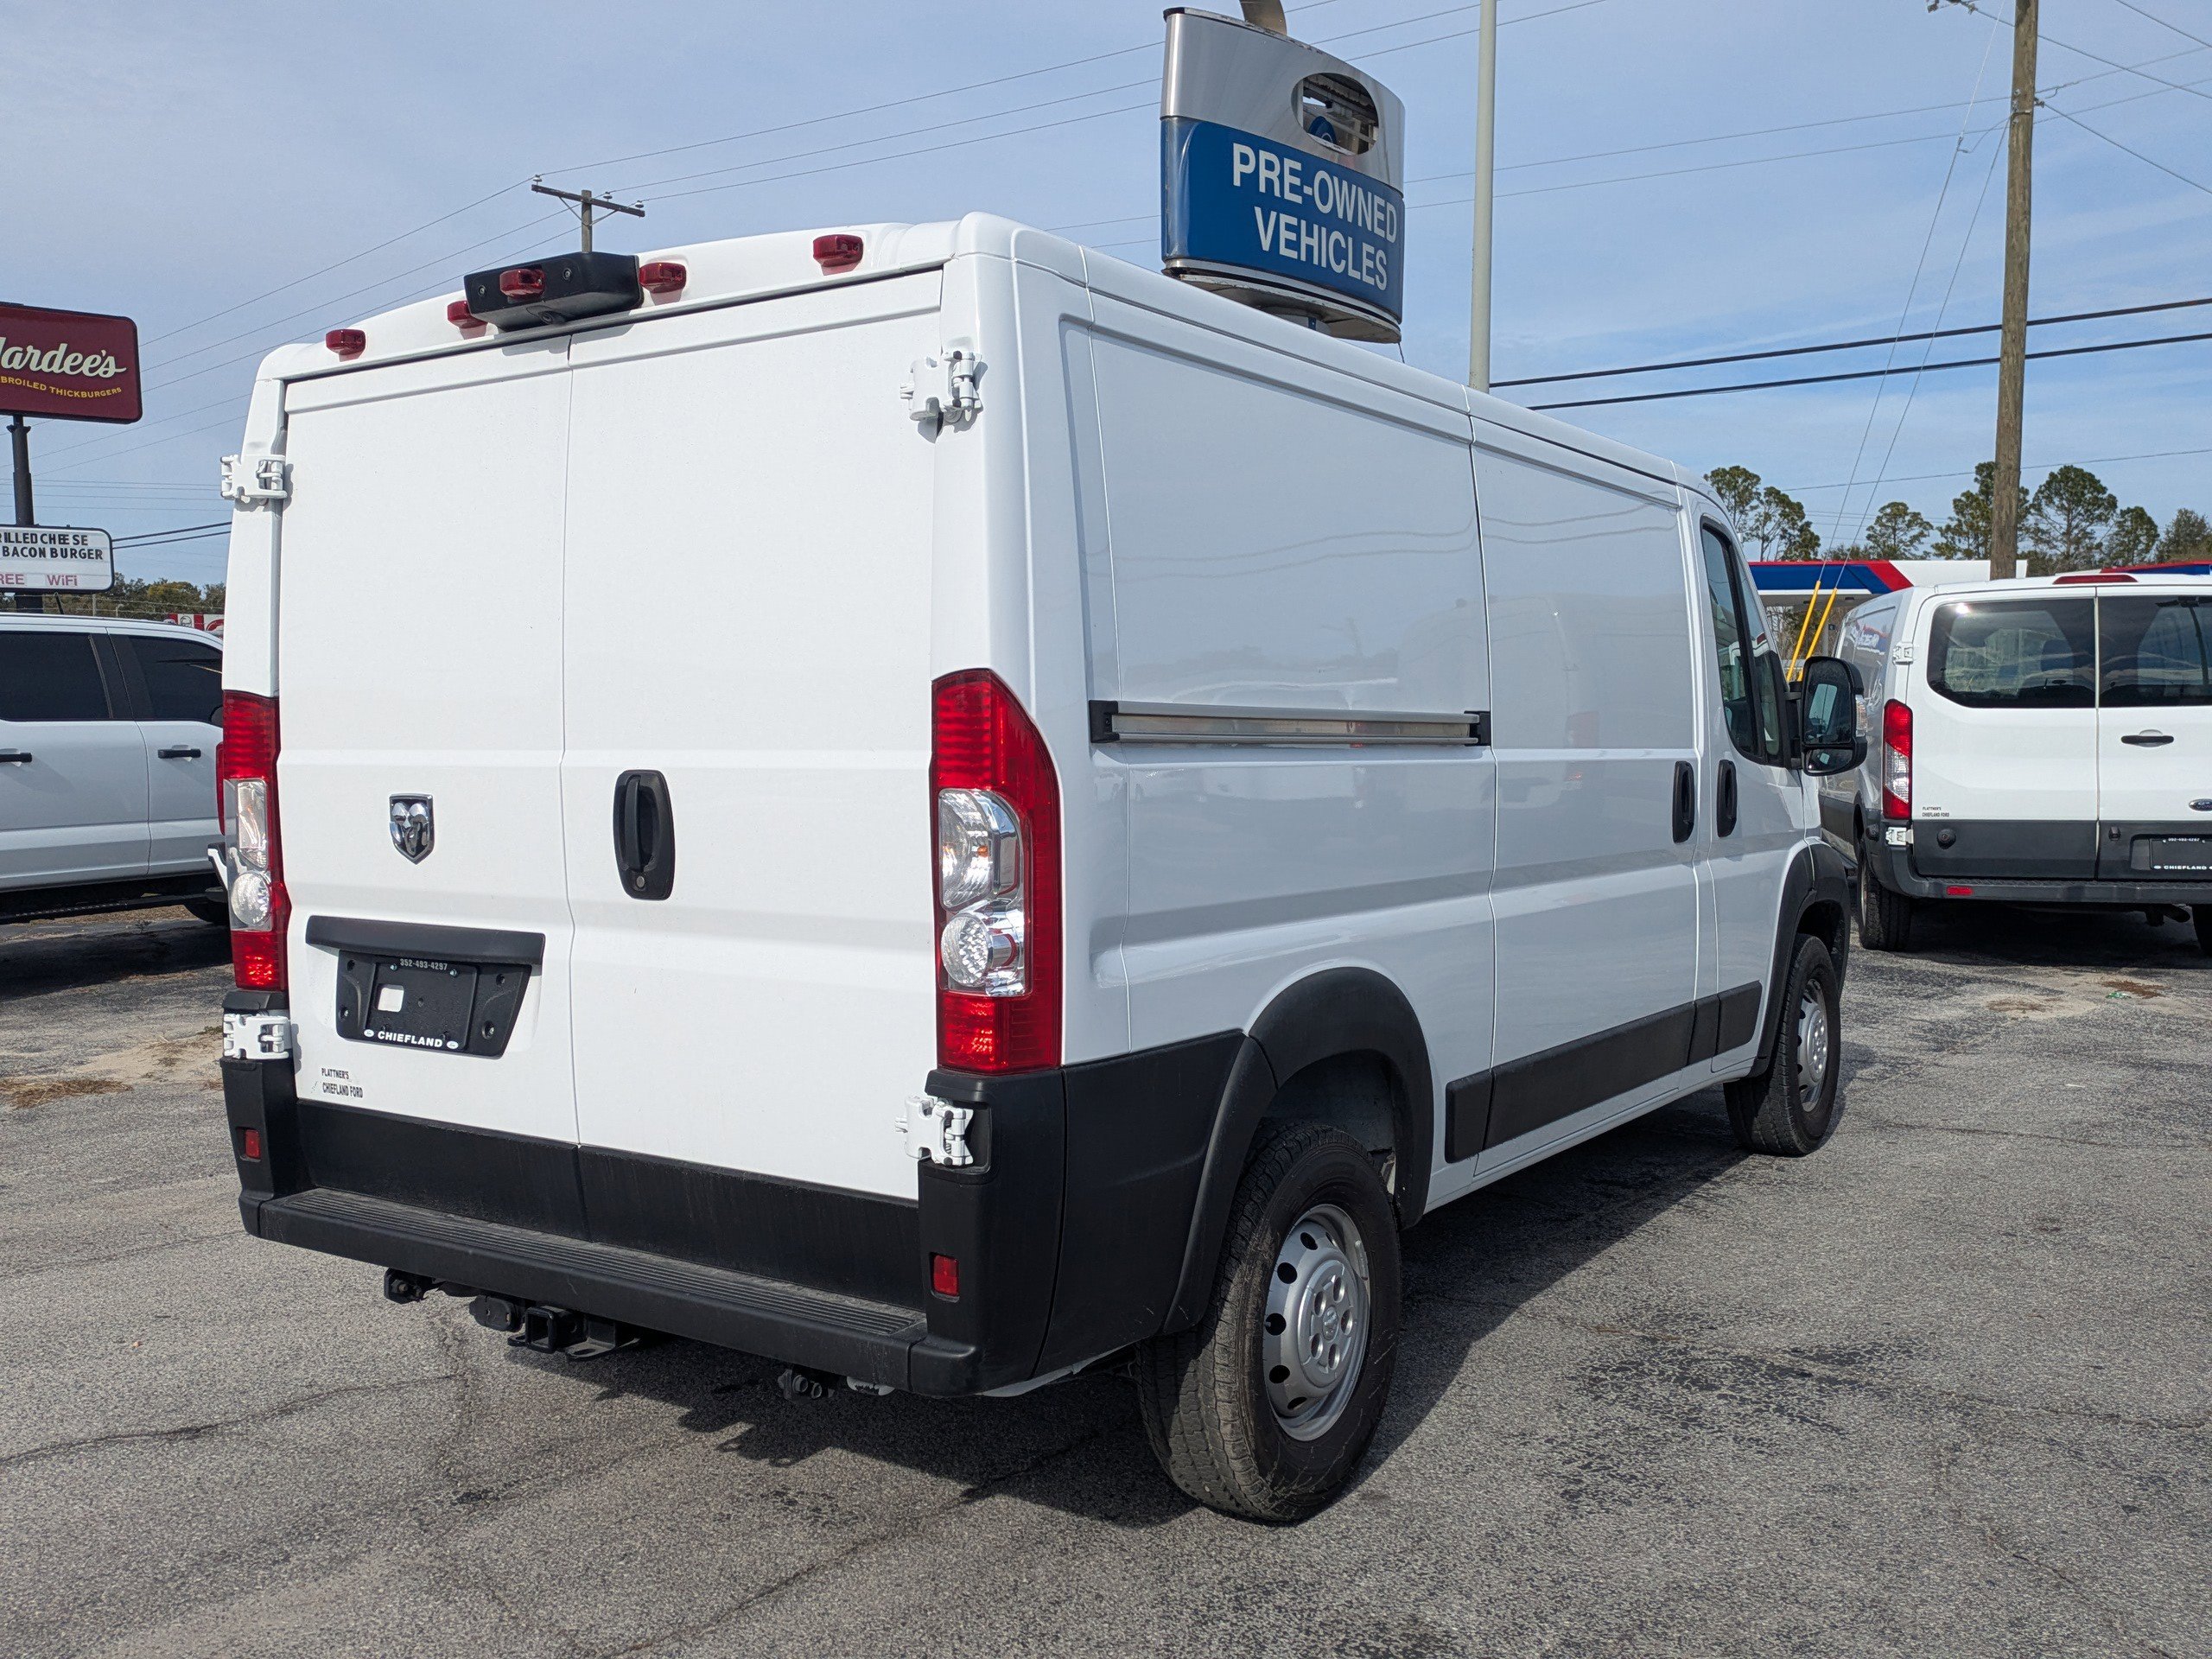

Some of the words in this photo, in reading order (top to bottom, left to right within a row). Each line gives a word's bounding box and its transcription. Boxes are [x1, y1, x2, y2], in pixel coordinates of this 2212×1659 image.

[1232, 143, 1397, 244] PRE-OWNED
[1254, 206, 1388, 291] VEHICLES
[0, 375, 47, 391] BROILED
[48, 385, 122, 398] THICKBURGERS
[2, 545, 47, 558] BACON
[49, 547, 103, 560] BURGER
[47, 574, 78, 586] WiFi
[400, 958, 448, 970] 352-493-4297
[378, 1031, 442, 1047] CHIEFLAND
[321, 1067, 350, 1080] PLATTNER'S
[322, 1082, 349, 1096] CHIEFLAND
[349, 1085, 364, 1098] FORD
